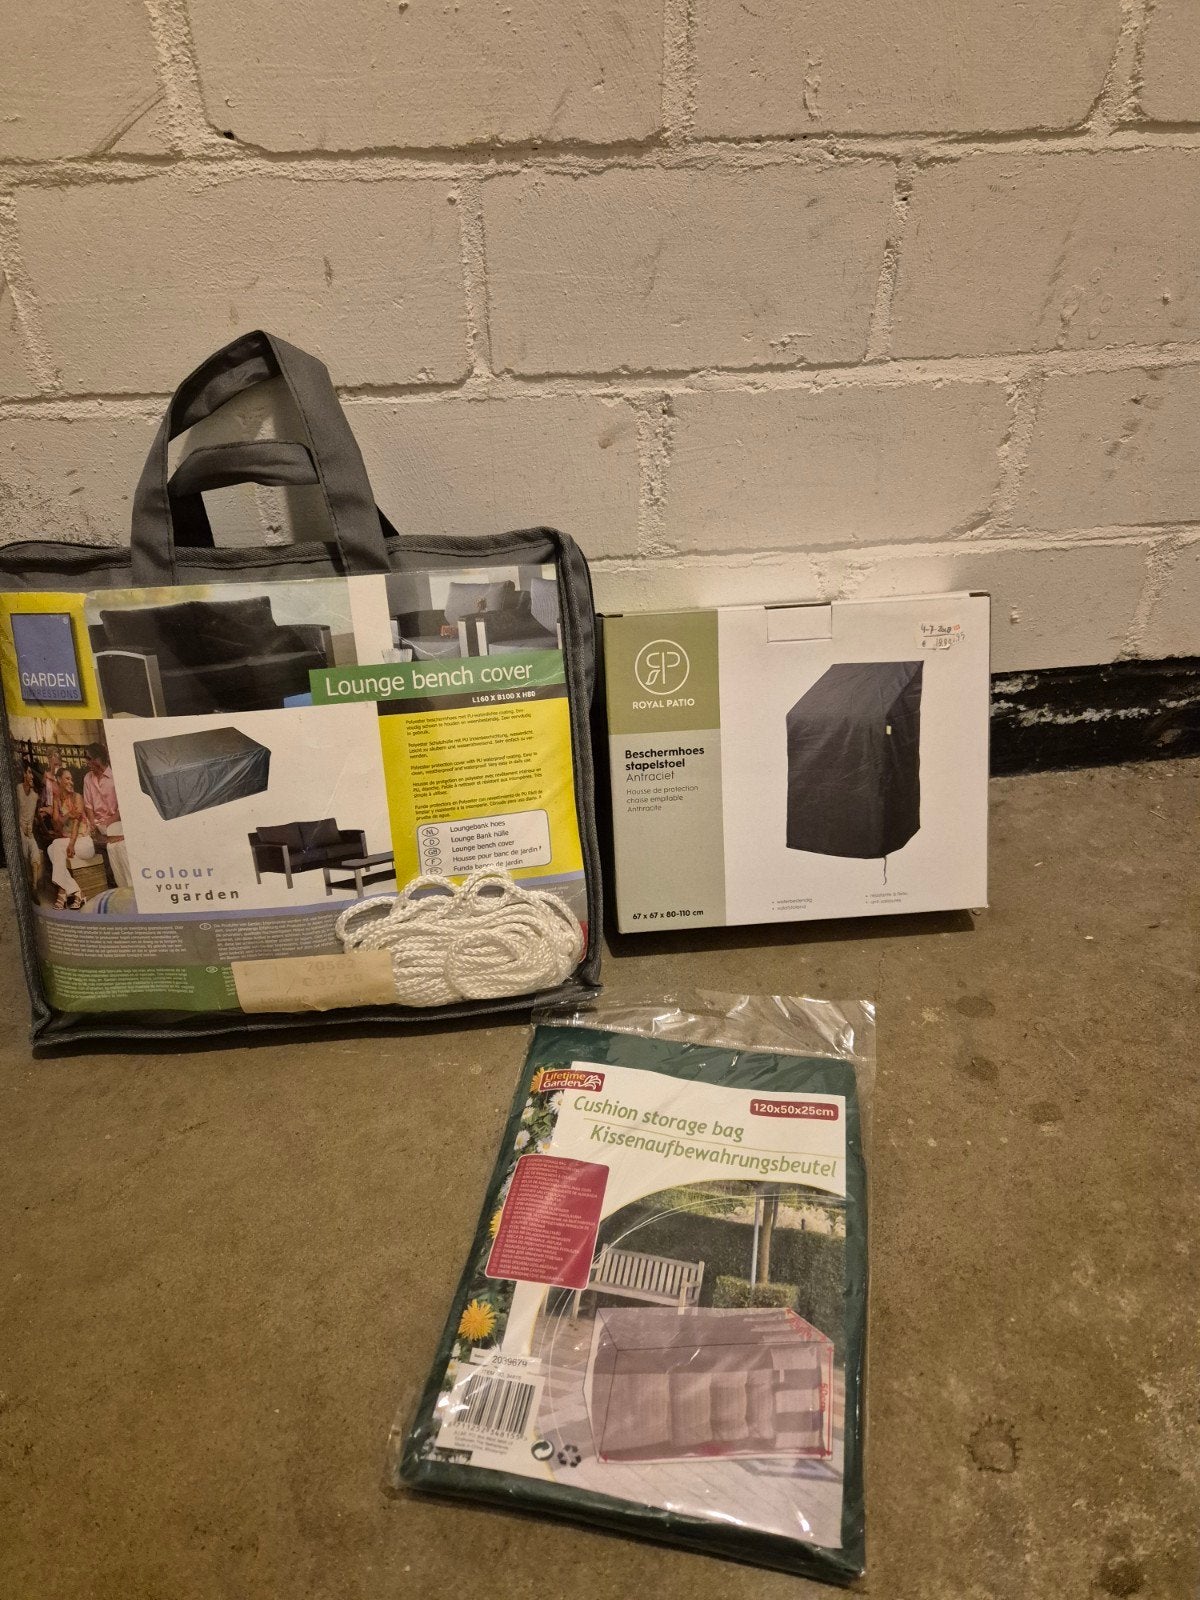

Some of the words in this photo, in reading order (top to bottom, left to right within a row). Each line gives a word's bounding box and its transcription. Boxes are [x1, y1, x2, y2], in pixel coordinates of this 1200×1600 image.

[22, 672, 76, 687] GARDEN
[325, 675, 405, 697] Lounge
[412, 666, 473, 690] bench
[481, 664, 533, 683] cover
[632, 700, 664, 710] ROYAL
[666, 698, 695, 708] PATIO
[625, 747, 705, 759] Beschermhoes
[625, 758, 685, 771] stapelstoel
[626, 771, 675, 782] Antraciet
[663, 785, 699, 794] protection
[449, 821, 489, 833] Loungebank
[490, 819, 506, 827] hoes
[450, 834, 475, 844] Lounge
[476, 831, 492, 840] Bank
[451, 844, 476, 855] Lounge
[477, 841, 497, 850] bench
[497, 839, 515, 847] cover
[452, 854, 476, 862] Housse
[477, 852, 492, 861] pour
[493, 849, 509, 858] banc
[510, 848, 519, 856] de
[520, 846, 538, 856] jardin
[141, 866, 214, 879] Colour
[453, 864, 474, 872] Funda
[156, 883, 190, 892] your
[170, 890, 239, 904] garden
[649, 911, 658, 919] 67
[666, 909, 691, 918] 80-110
[545, 1072, 586, 1081] Lifetime
[543, 1079, 582, 1088] Garden
[753, 1102, 835, 1117] 120x50x25cm
[573, 1095, 638, 1121] Cushion
[641, 1110, 708, 1137] storage
[712, 1120, 745, 1143] bag
[590, 1124, 838, 1178] Kissenaufbewahrungsbeutel
